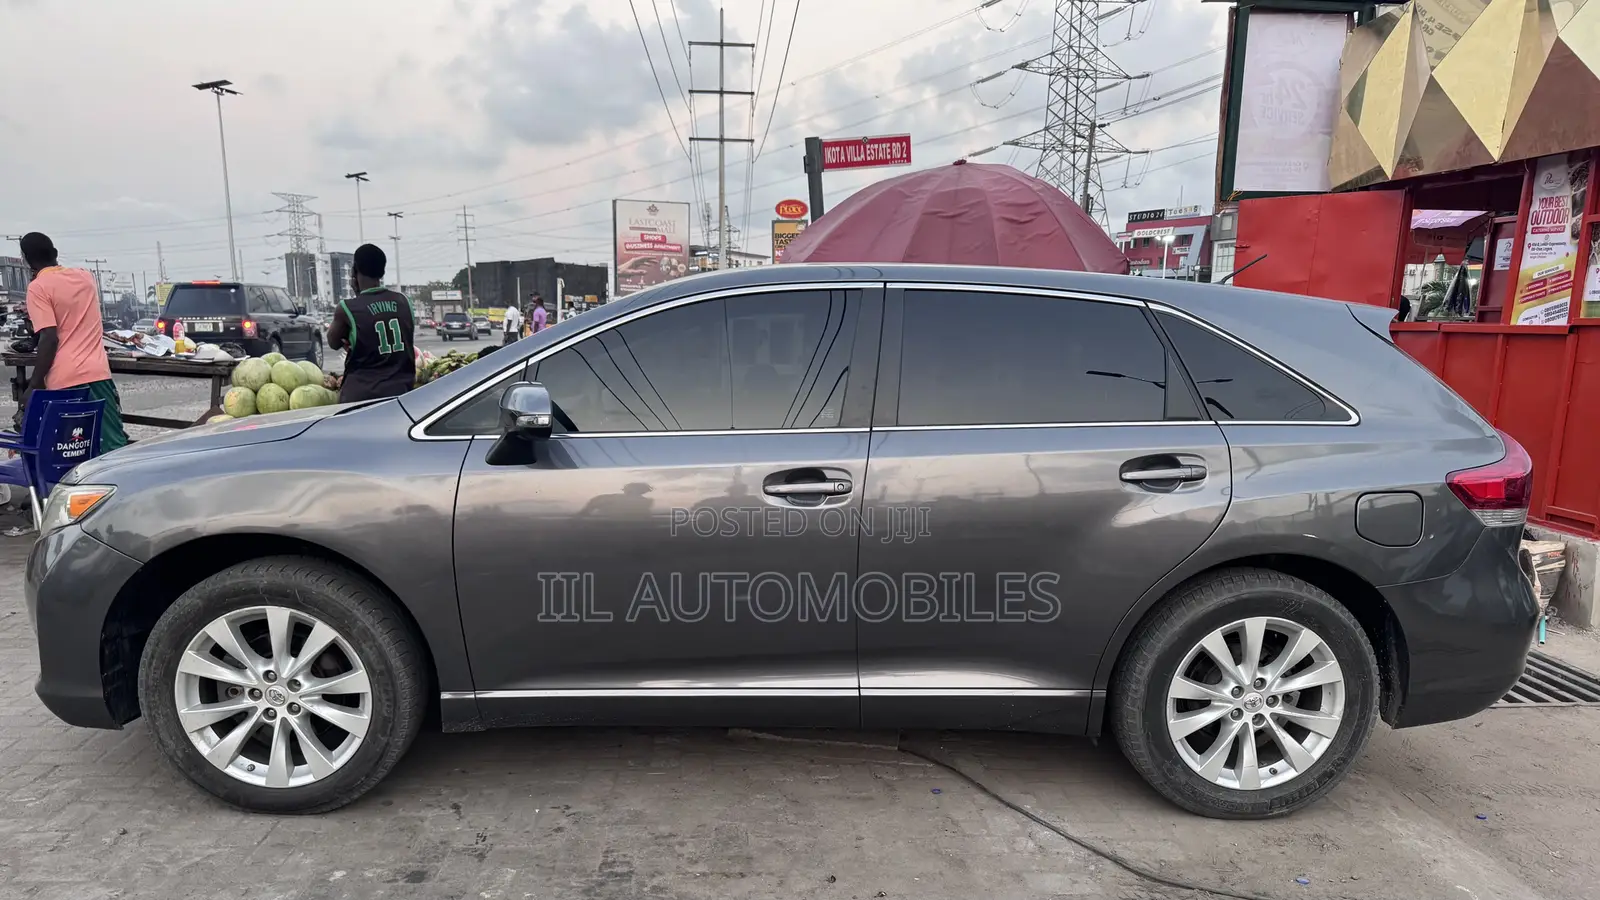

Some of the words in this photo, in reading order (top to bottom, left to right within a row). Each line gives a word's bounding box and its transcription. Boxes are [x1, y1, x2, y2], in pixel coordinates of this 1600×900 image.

[824, 146, 846, 164] IKOTA
[846, 144, 865, 162] VILLA
[866, 143, 890, 160] ESTATE
[892, 142, 901, 158] RD
[902, 141, 907, 158] 2
[1538, 196, 1554, 209] YOUR
[1555, 195, 1568, 208] BEST
[1128, 212, 1154, 221] STUDIO
[1531, 208, 1570, 226] OUTDOOR
[367, 301, 398, 315] IRVING
[375, 318, 404, 355] 11
[57, 439, 90, 450] DANGOTE
[63, 449, 86, 457] CEMENT
